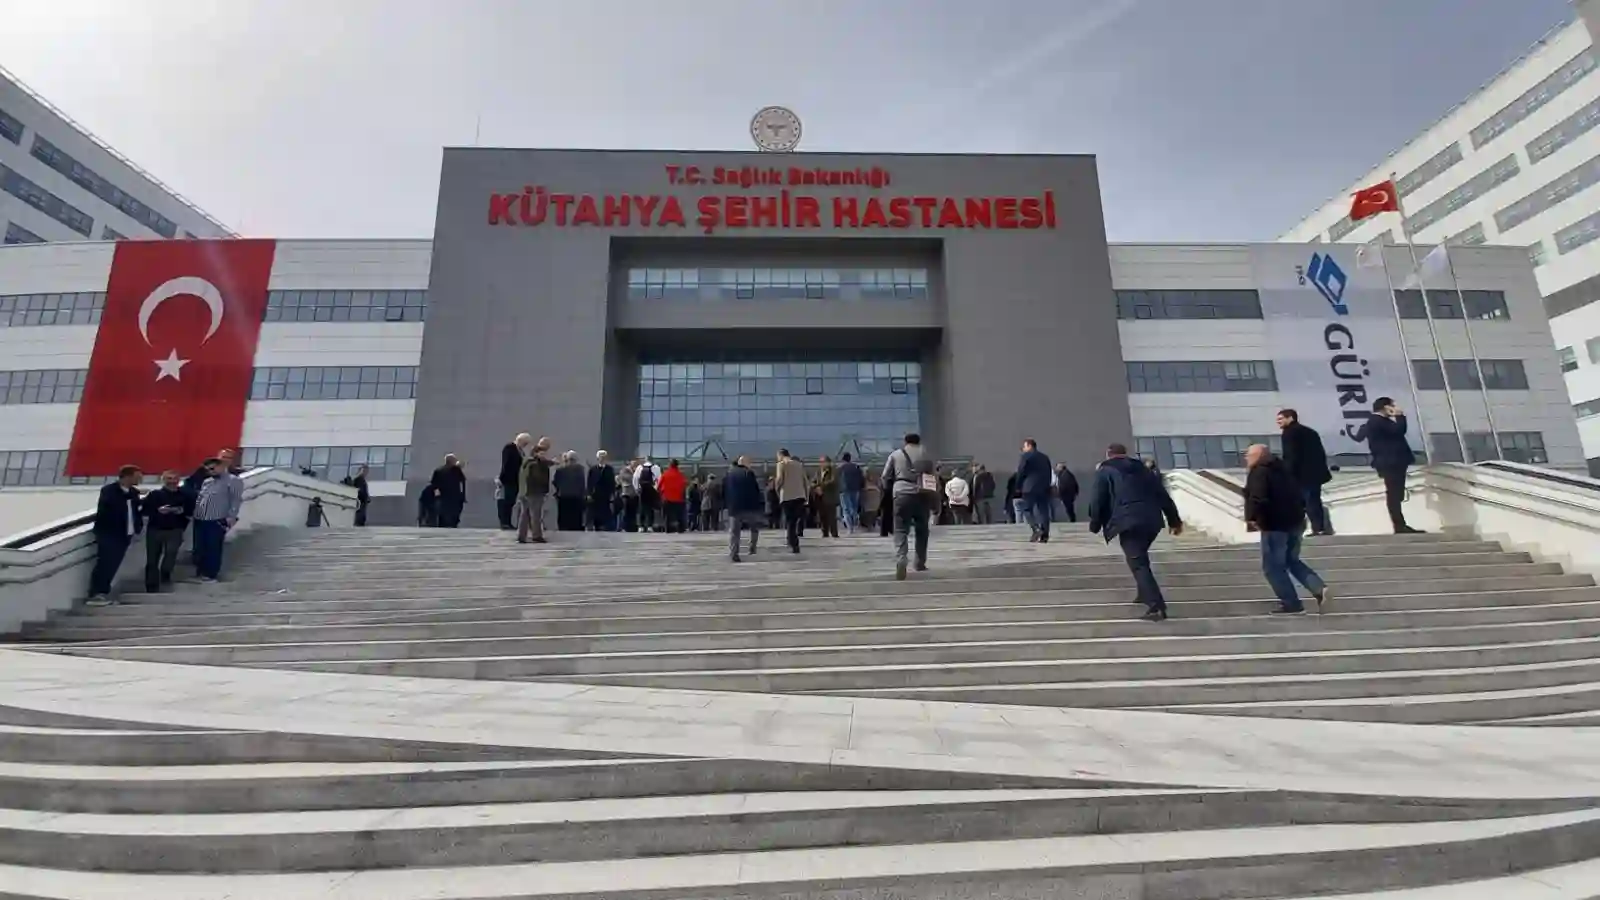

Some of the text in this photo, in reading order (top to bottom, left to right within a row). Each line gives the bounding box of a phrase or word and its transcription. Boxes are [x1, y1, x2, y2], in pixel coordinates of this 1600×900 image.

[665, 164, 890, 189] T.C. Sağlık Bakanlığı
[489, 187, 1057, 234] KÜTAHYA ŞEHİR HASTANESİ
